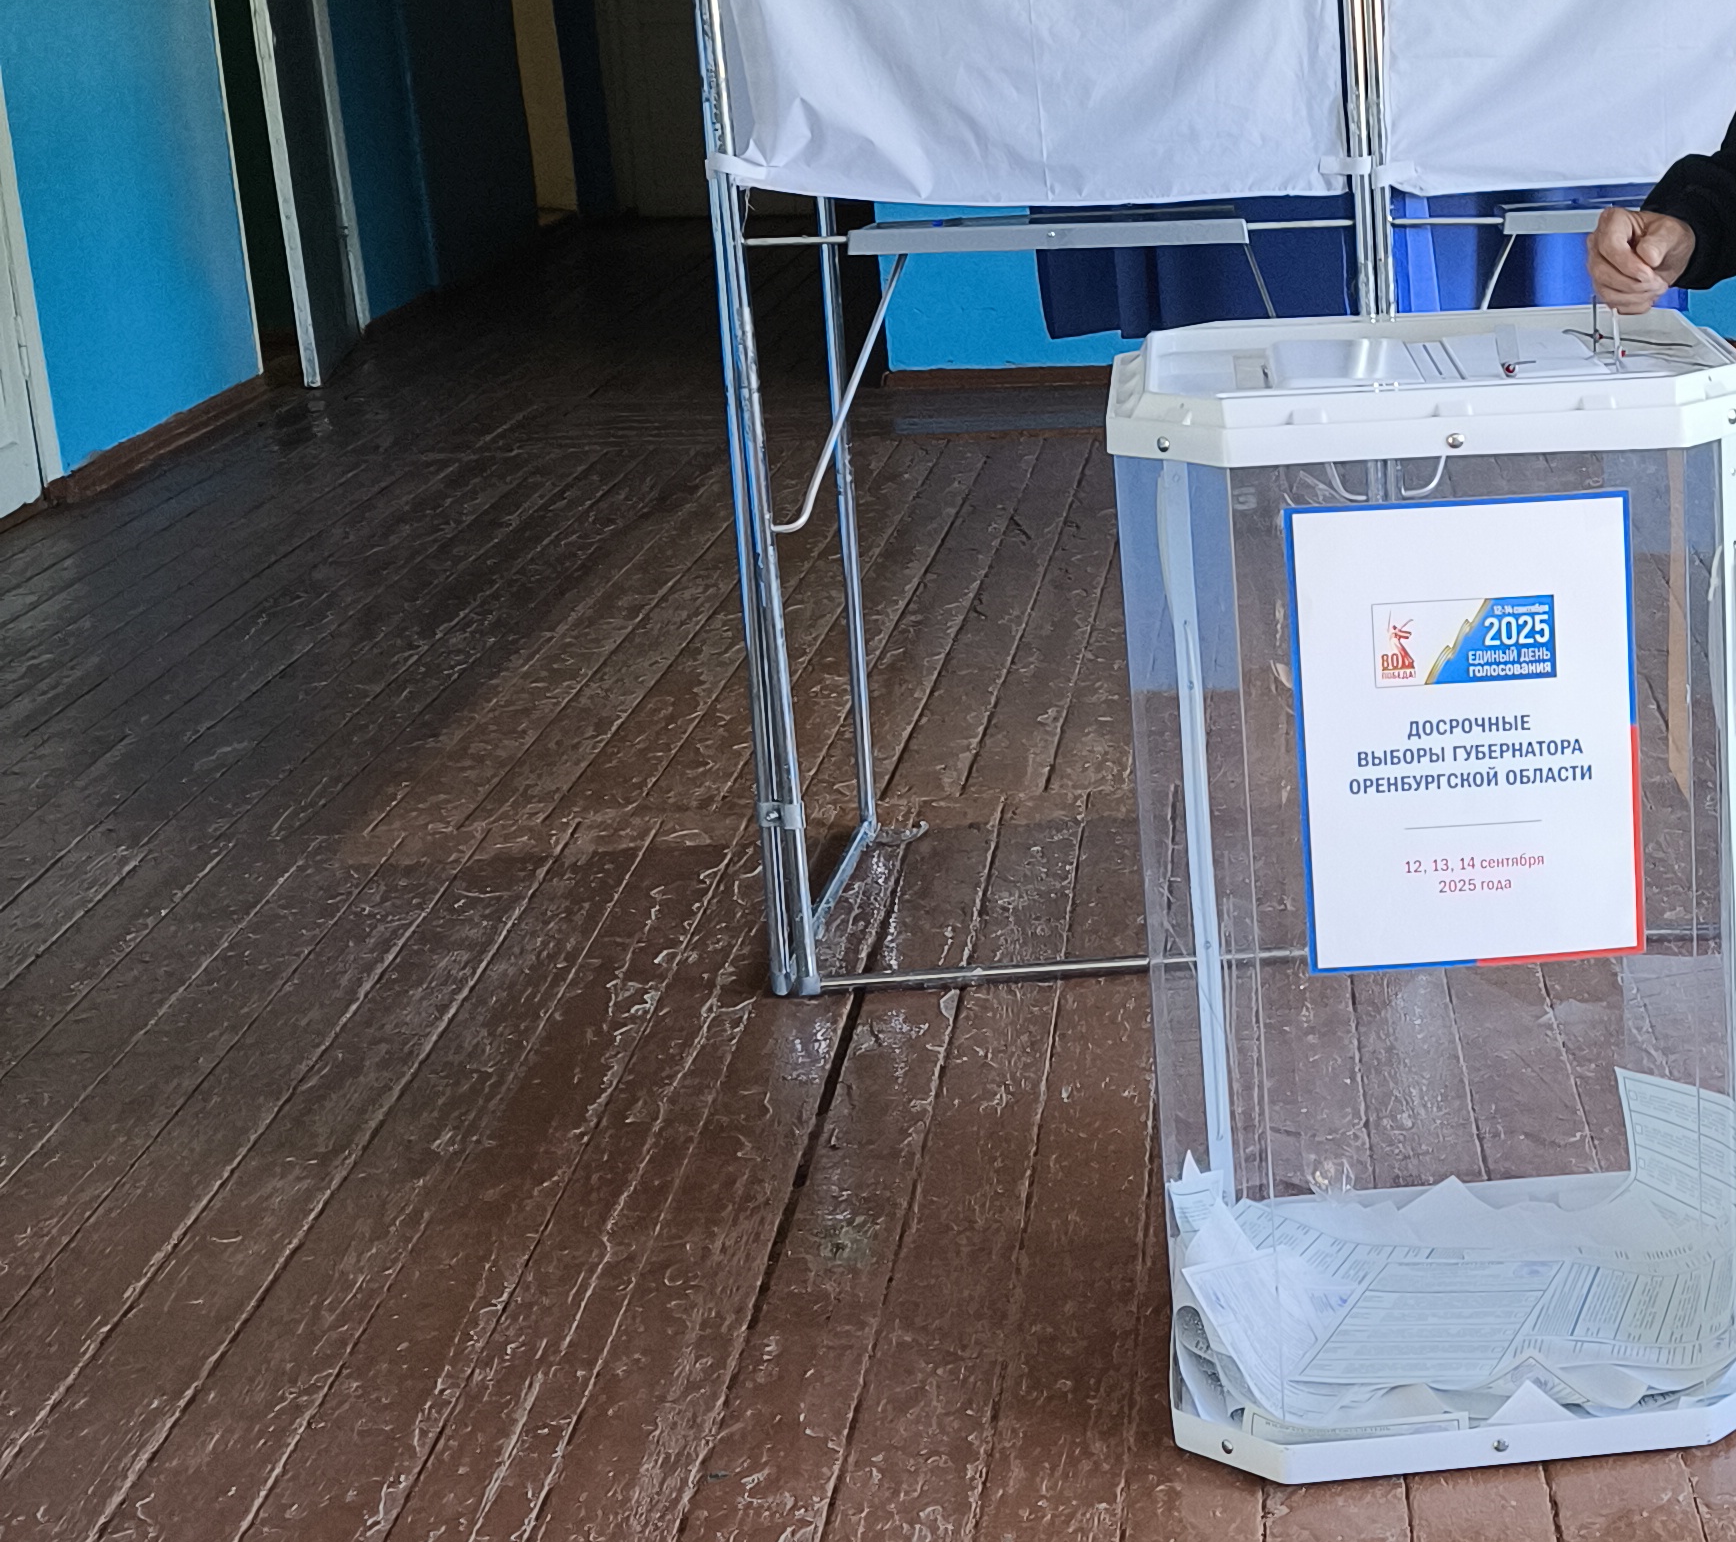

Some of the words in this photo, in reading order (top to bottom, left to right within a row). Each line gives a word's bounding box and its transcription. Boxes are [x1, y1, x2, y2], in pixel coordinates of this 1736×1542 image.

[1484, 614, 1550, 646] 2025
[1468, 647, 1518, 664] ЕДИНЫЙ
[1520, 647, 1551, 662] ДЕНЬ
[1407, 714, 1531, 740] ДОСРОЧНЫЕ
[1357, 746, 1445, 768] ВЫБОРЫ
[1452, 738, 1583, 762] ГУБЕРНАТОРА
[1349, 767, 1499, 795] ОРЕНБУРГСКОЙ
[1505, 764, 1593, 786] ОБЛАСТИ
[1405, 860, 1427, 875] 12,
[1432, 858, 1454, 872] 13,
[1459, 856, 1475, 870] 14
[1480, 853, 1545, 869] сентября
[1439, 879, 1476, 893] 2025
[1480, 879, 1512, 891] года
